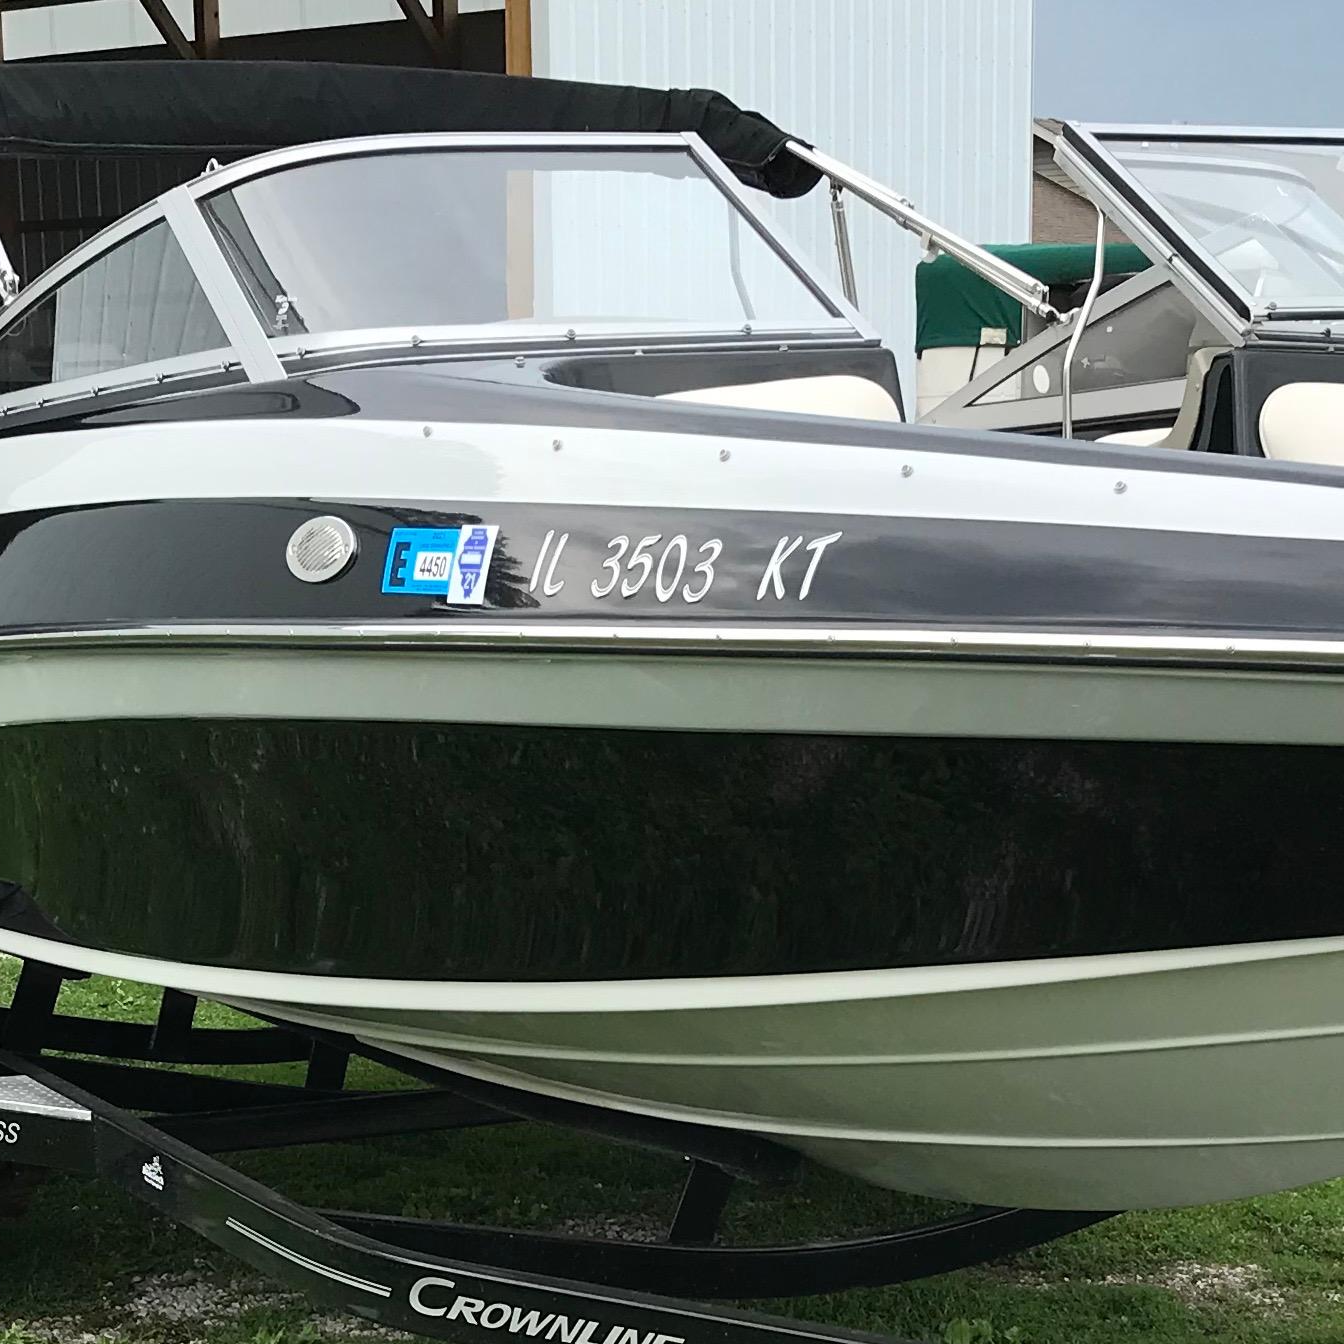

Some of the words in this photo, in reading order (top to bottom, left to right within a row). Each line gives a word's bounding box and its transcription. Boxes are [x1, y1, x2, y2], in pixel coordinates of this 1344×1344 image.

[388, 541, 412, 587] E
[418, 555, 447, 578] 4450
[529, 529, 568, 598] IL
[590, 532, 723, 603] 3503
[756, 531, 843, 601] KT
[463, 572, 476, 591] 21
